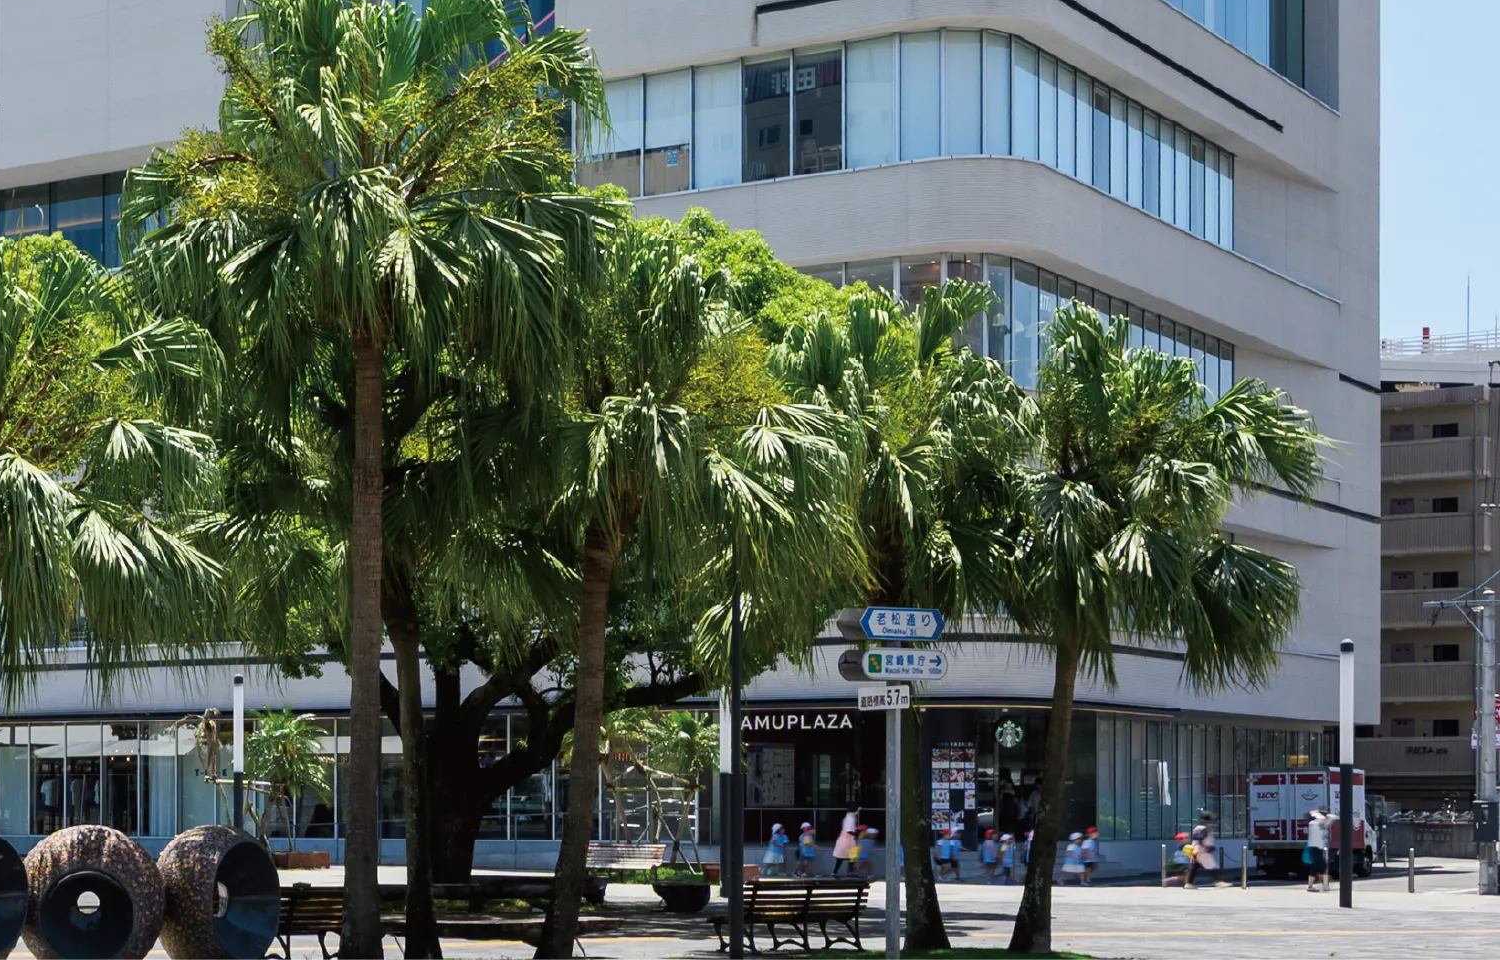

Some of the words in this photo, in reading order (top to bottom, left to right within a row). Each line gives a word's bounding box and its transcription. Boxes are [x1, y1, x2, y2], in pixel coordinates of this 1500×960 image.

[877, 612, 931, 627] 老松通り
[885, 654, 926, 667] 宮崎県庁
[740, 714, 853, 730] AMUPLAZA
